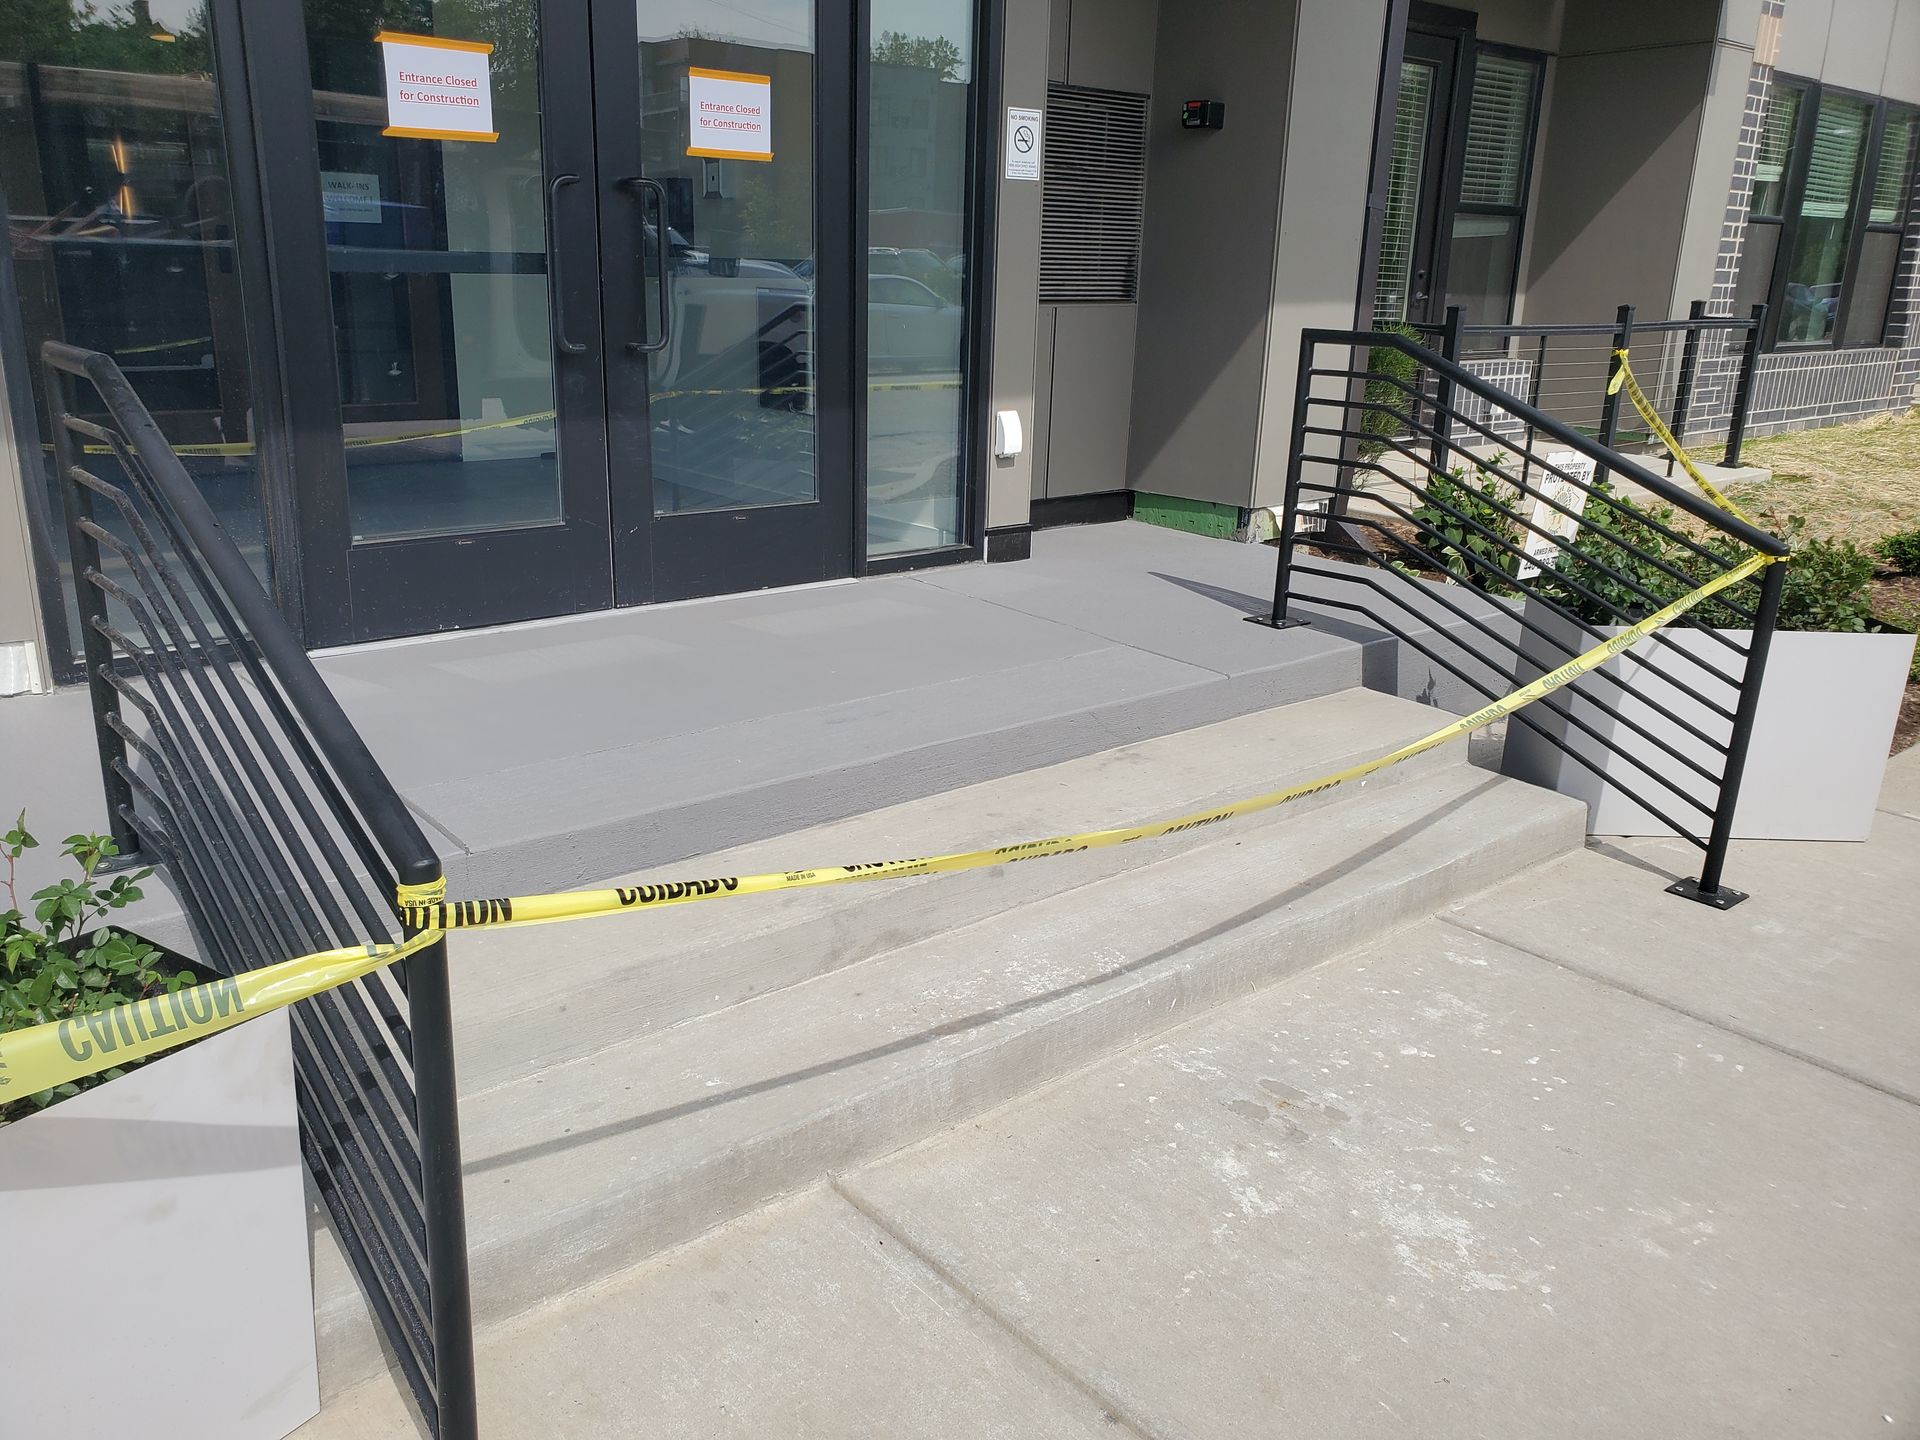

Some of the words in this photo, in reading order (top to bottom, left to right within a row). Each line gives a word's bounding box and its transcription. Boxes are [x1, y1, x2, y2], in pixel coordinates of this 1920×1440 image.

[399, 72, 443, 84] Entrance
[445, 75, 477, 87] Closed
[400, 90, 414, 100] for
[417, 92, 479, 105] Construction
[700, 101, 734, 112] Entrance
[735, 104, 761, 115] Closed
[700, 117, 711, 125] for
[713, 118, 761, 130] Construction
[1565, 462, 1587, 470] PROPERTY
[1581, 470, 1592, 481] BY
